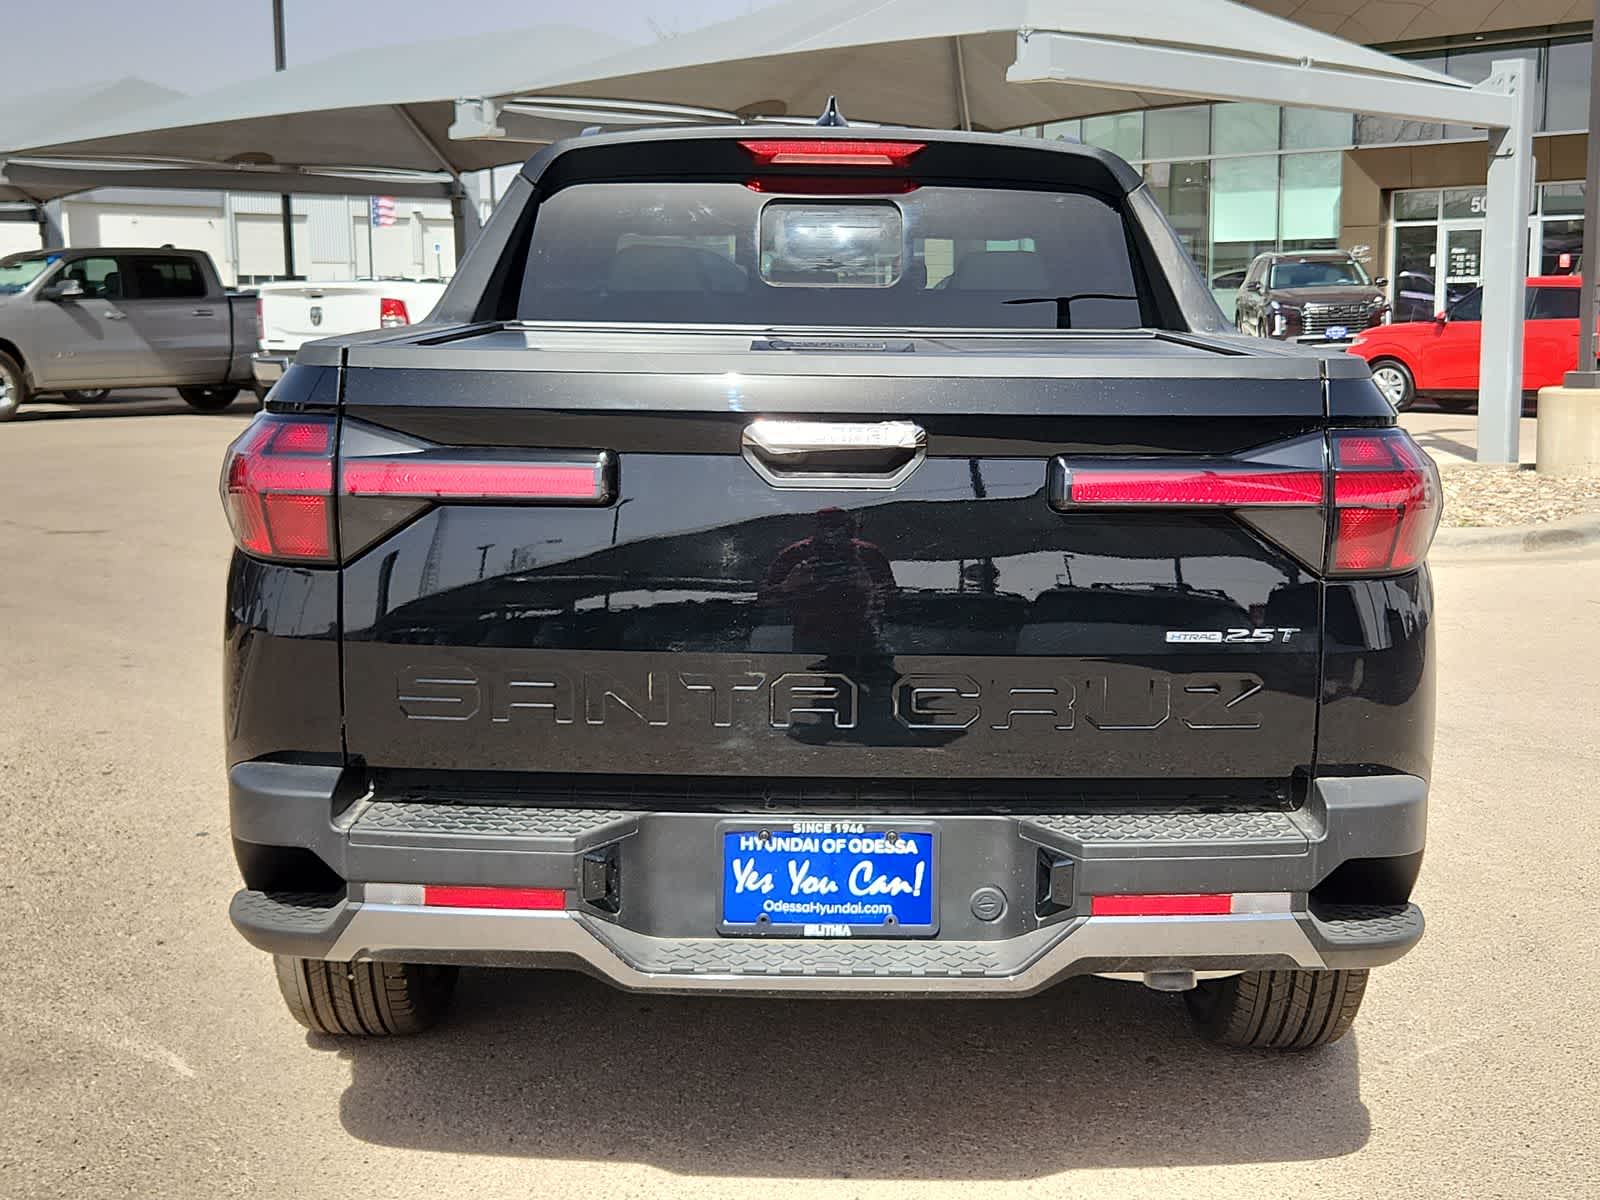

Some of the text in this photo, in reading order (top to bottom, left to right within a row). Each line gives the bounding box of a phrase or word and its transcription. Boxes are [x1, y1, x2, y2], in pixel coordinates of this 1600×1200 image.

[398, 665, 1263, 731] SANTA CRUZ
[793, 824, 865, 834] SINCE 1946
[740, 837, 918, 854] HYUNDAI OF ODESSA
[732, 858, 926, 897] Yes You Can!
[763, 899, 892, 915] OdessaHyundai.com
